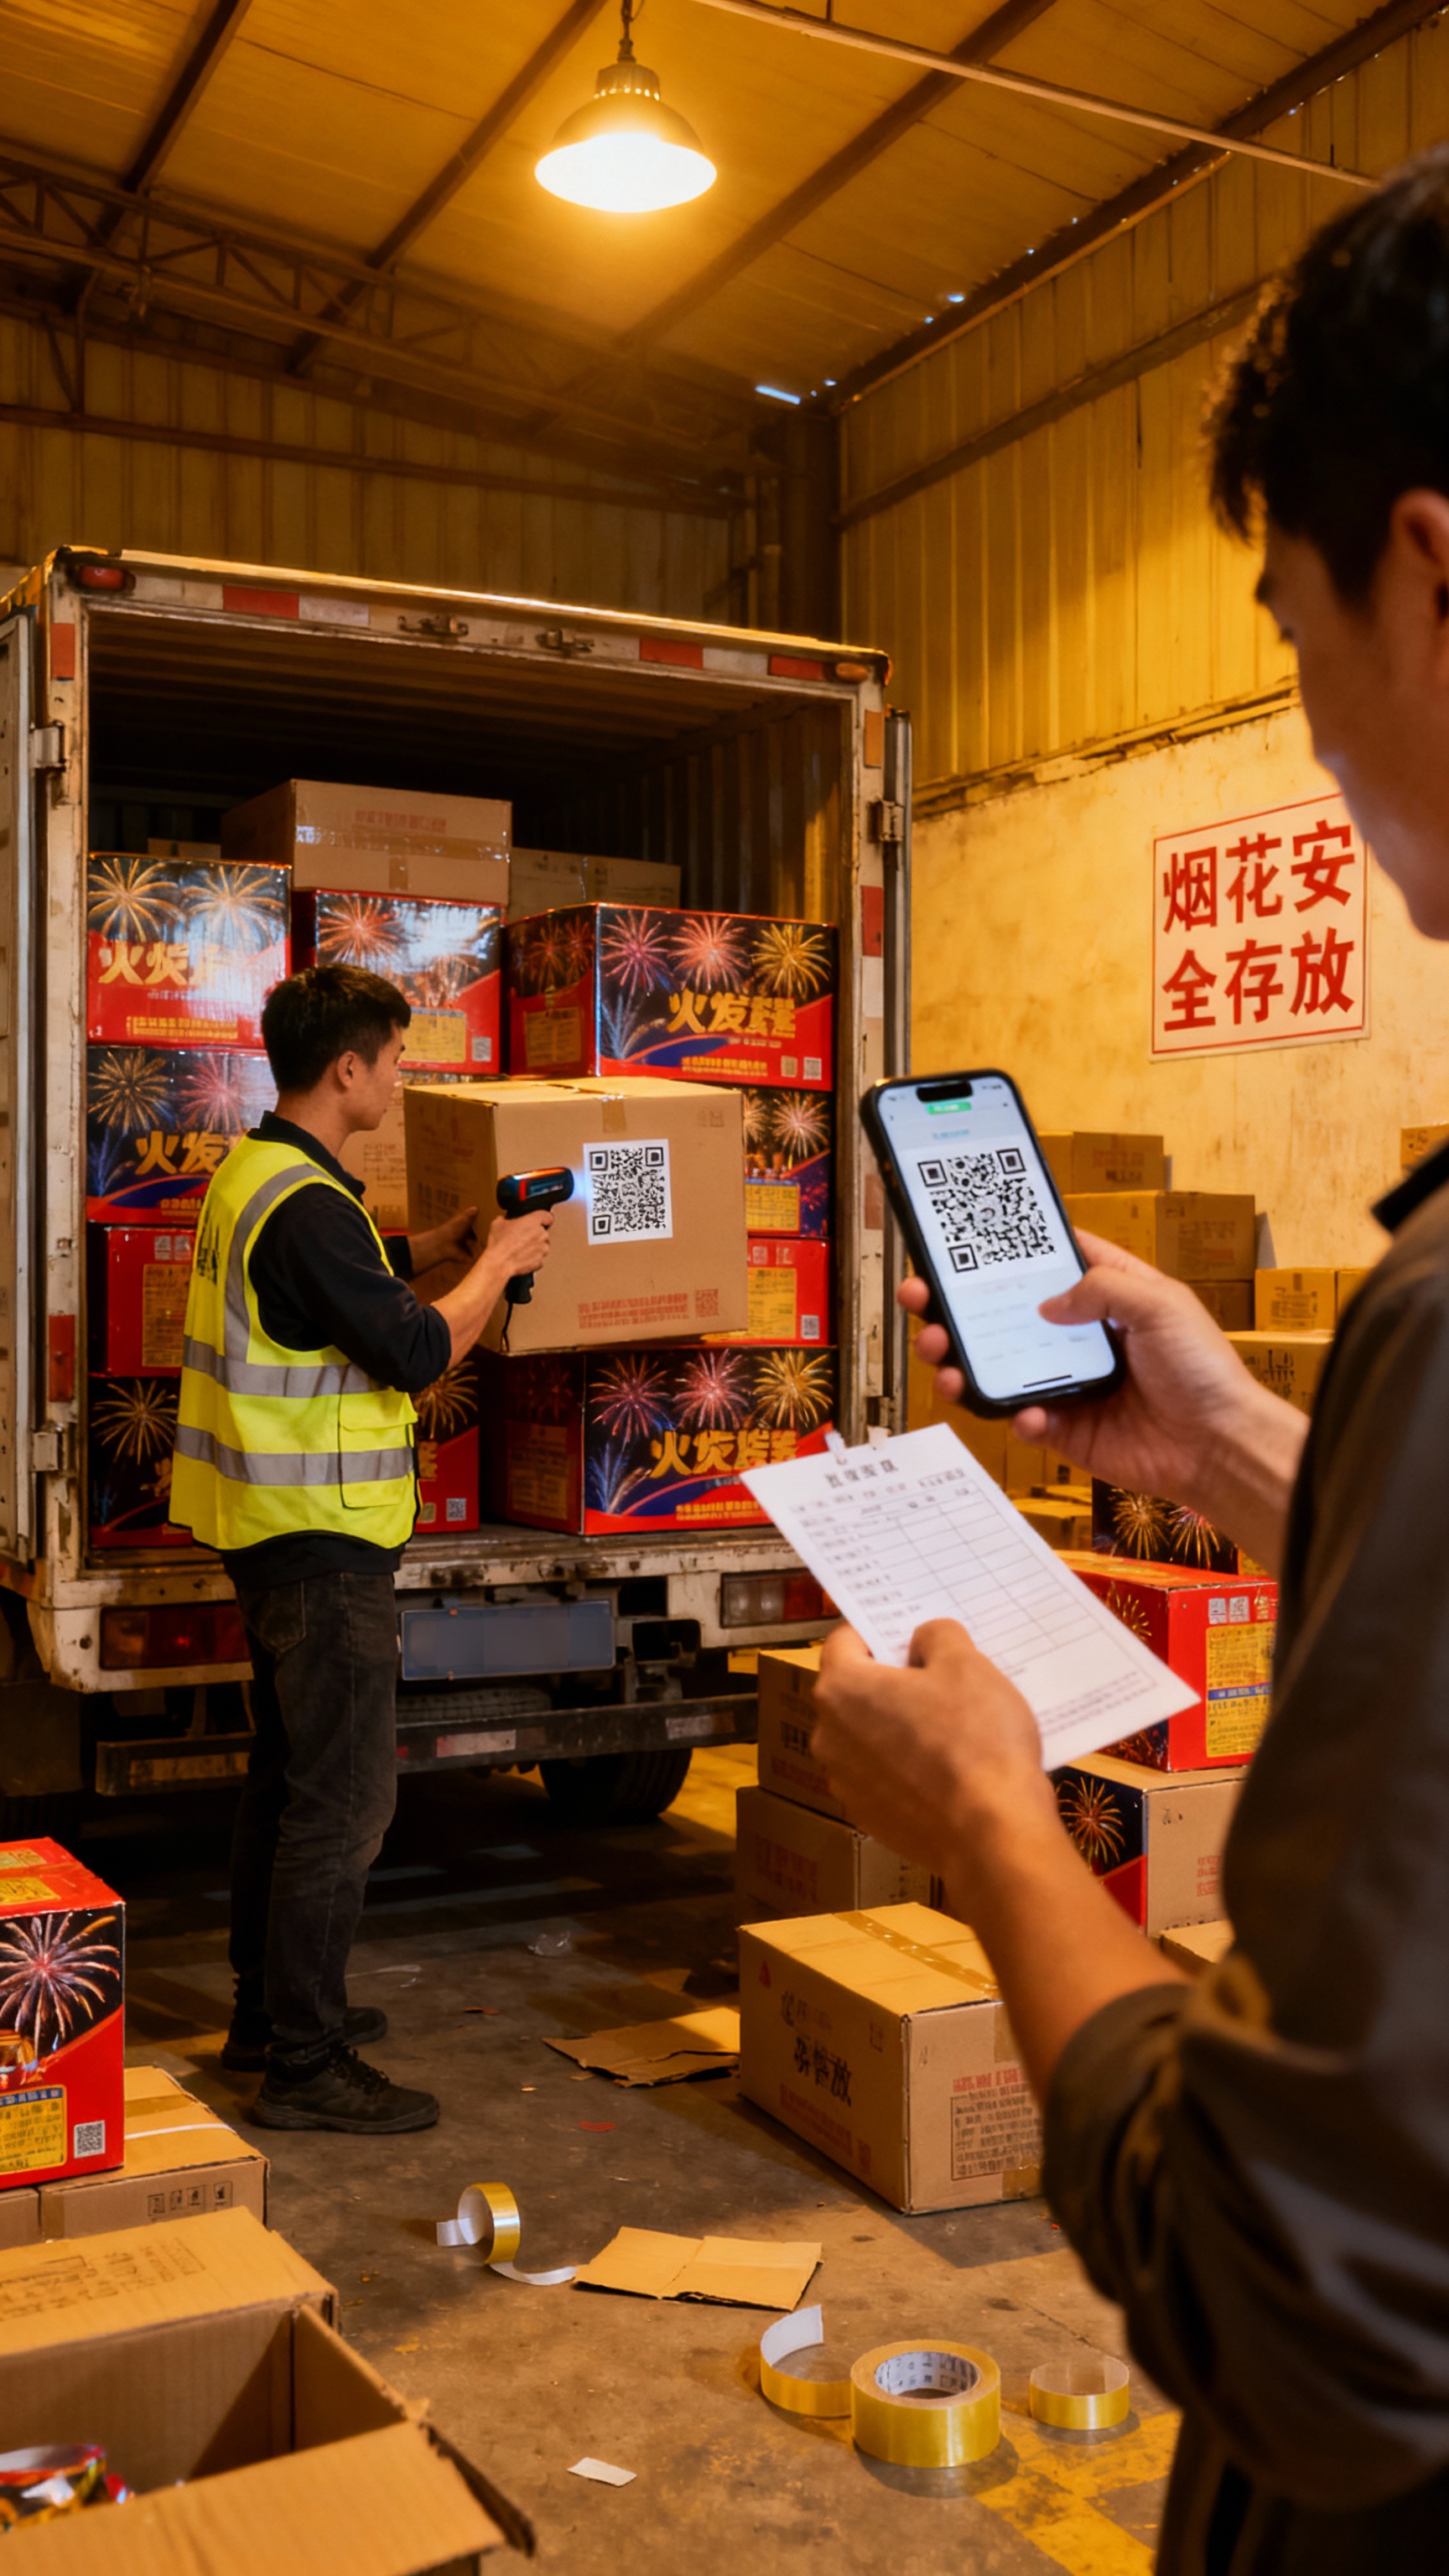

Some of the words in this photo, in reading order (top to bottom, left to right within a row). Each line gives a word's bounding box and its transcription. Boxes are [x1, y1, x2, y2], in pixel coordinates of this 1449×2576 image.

[1163, 819, 1355, 934] 烟花安
[1161, 926, 1355, 1032] 全存放
